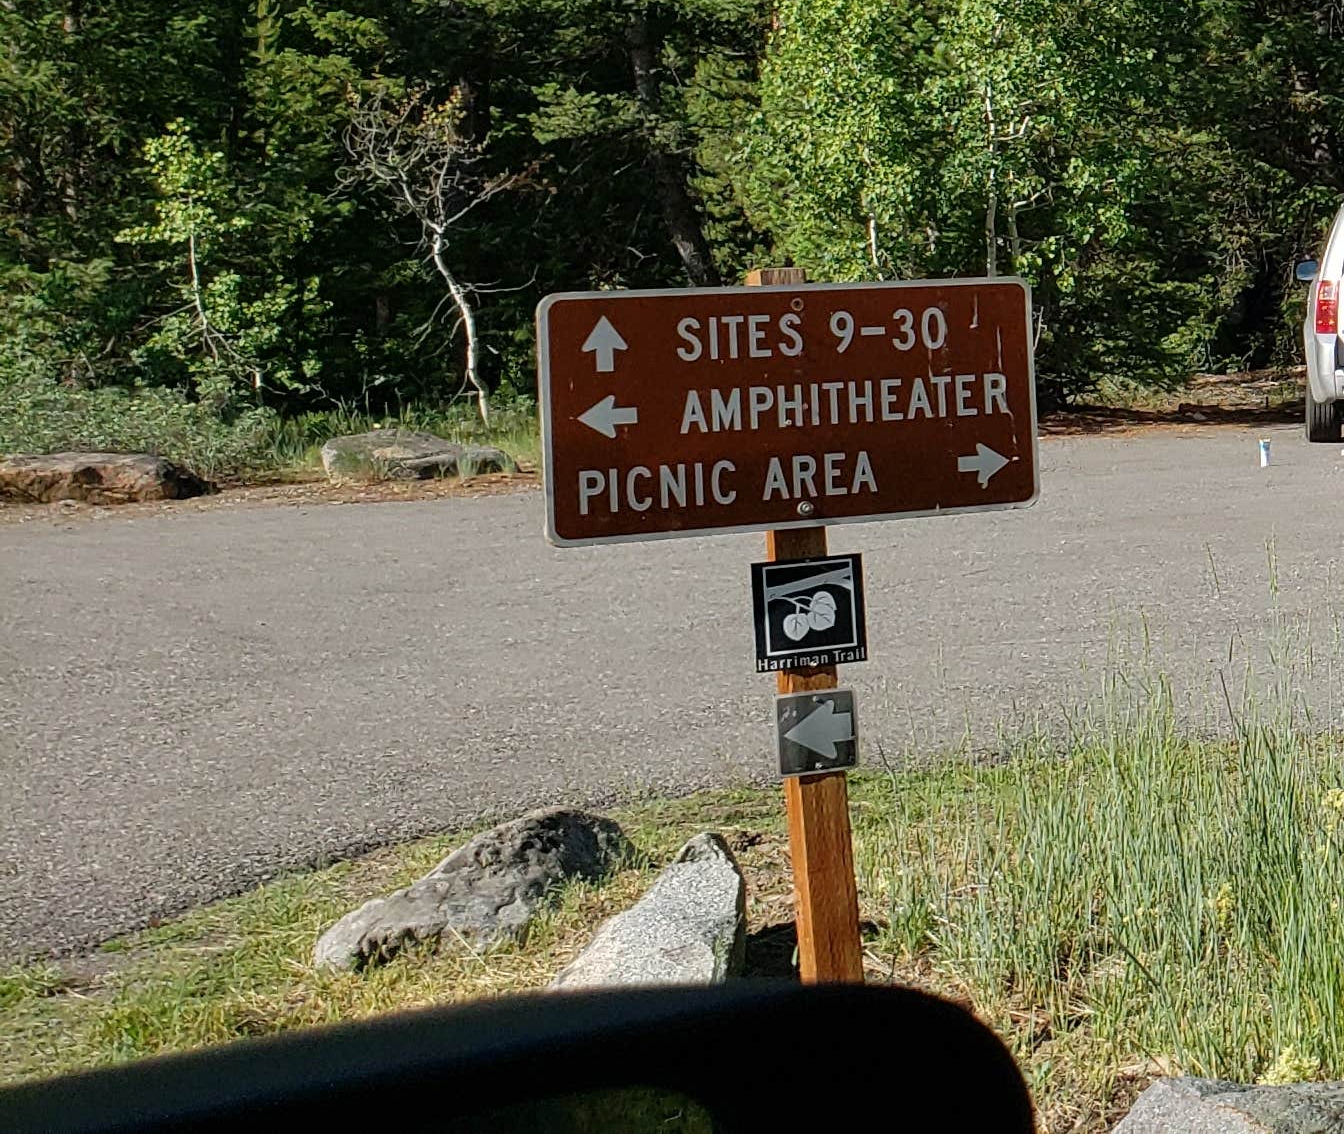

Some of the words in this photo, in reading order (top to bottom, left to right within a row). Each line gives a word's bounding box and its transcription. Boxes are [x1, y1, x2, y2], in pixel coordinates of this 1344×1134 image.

[676, 313, 804, 362] SITES
[830, 306, 947, 354] 9-30
[680, 373, 1010, 434] AMPHITHEATER
[578, 460, 737, 515] PICNIC
[762, 451, 879, 500] AREA
[758, 653, 829, 672] Harriman
[832, 646, 866, 663] Trail
